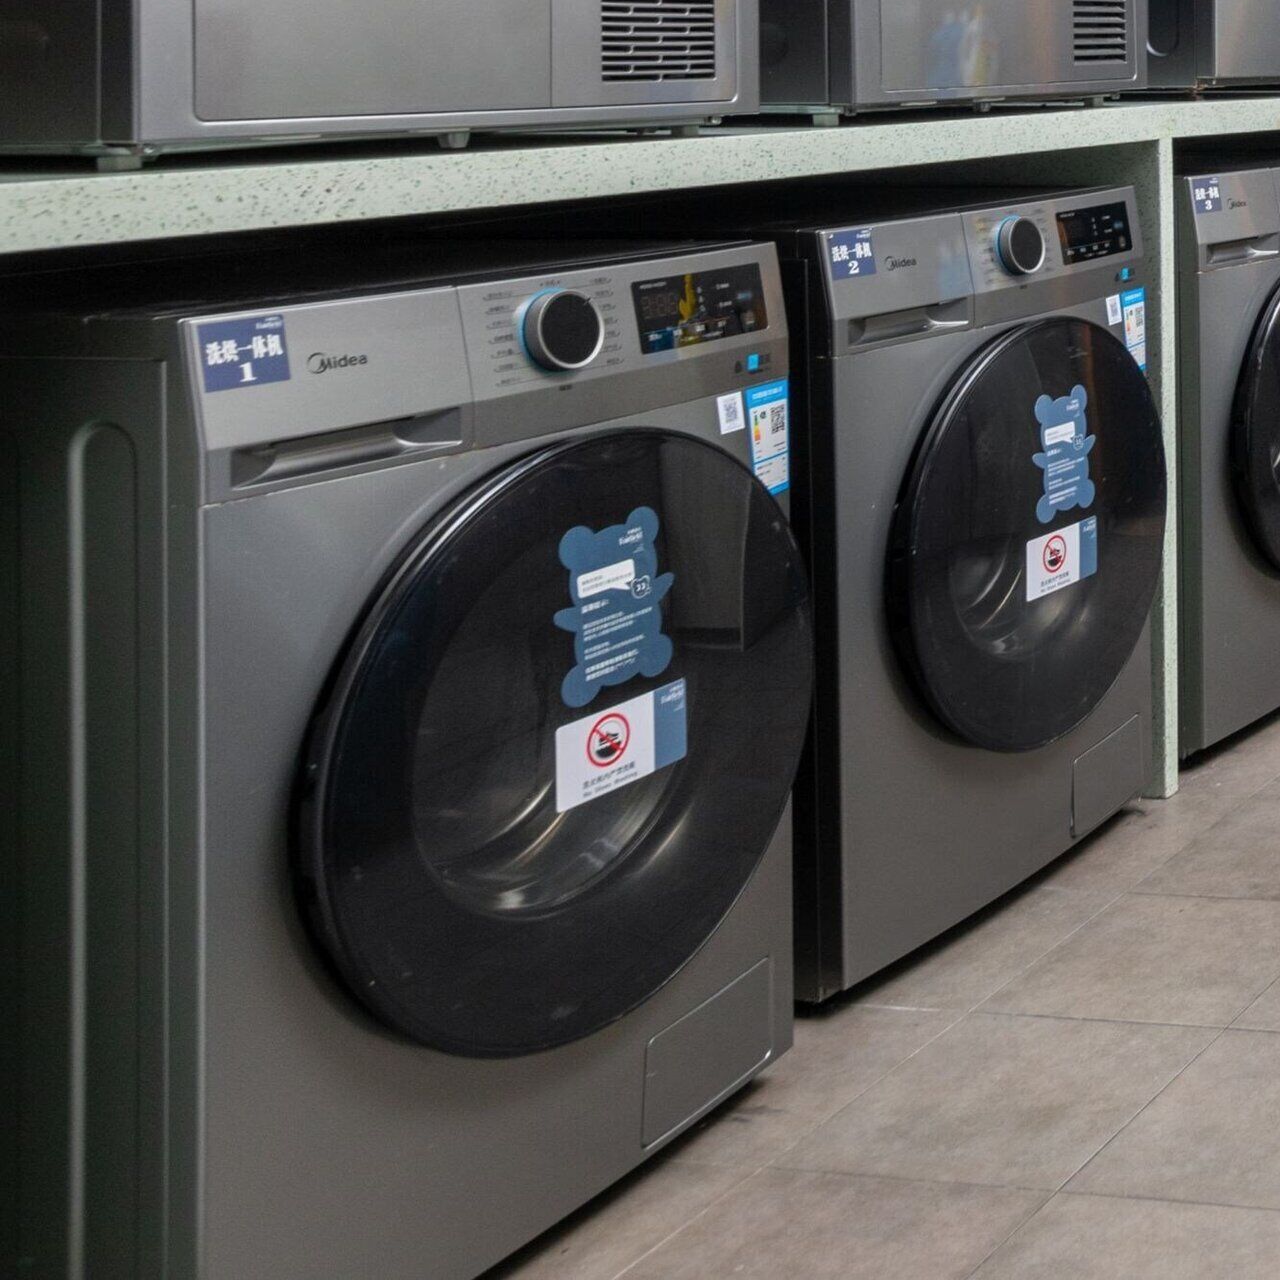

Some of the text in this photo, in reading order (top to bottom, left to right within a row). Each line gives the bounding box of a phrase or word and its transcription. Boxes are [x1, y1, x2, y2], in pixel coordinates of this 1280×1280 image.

[1204, 199, 1213, 210] 3
[848, 260, 861, 275] 2
[884, 255, 918, 272] Midea
[206, 334, 284, 366] 洗烘一体机
[238, 362, 258, 383] 1
[307, 351, 369, 375] Midea
